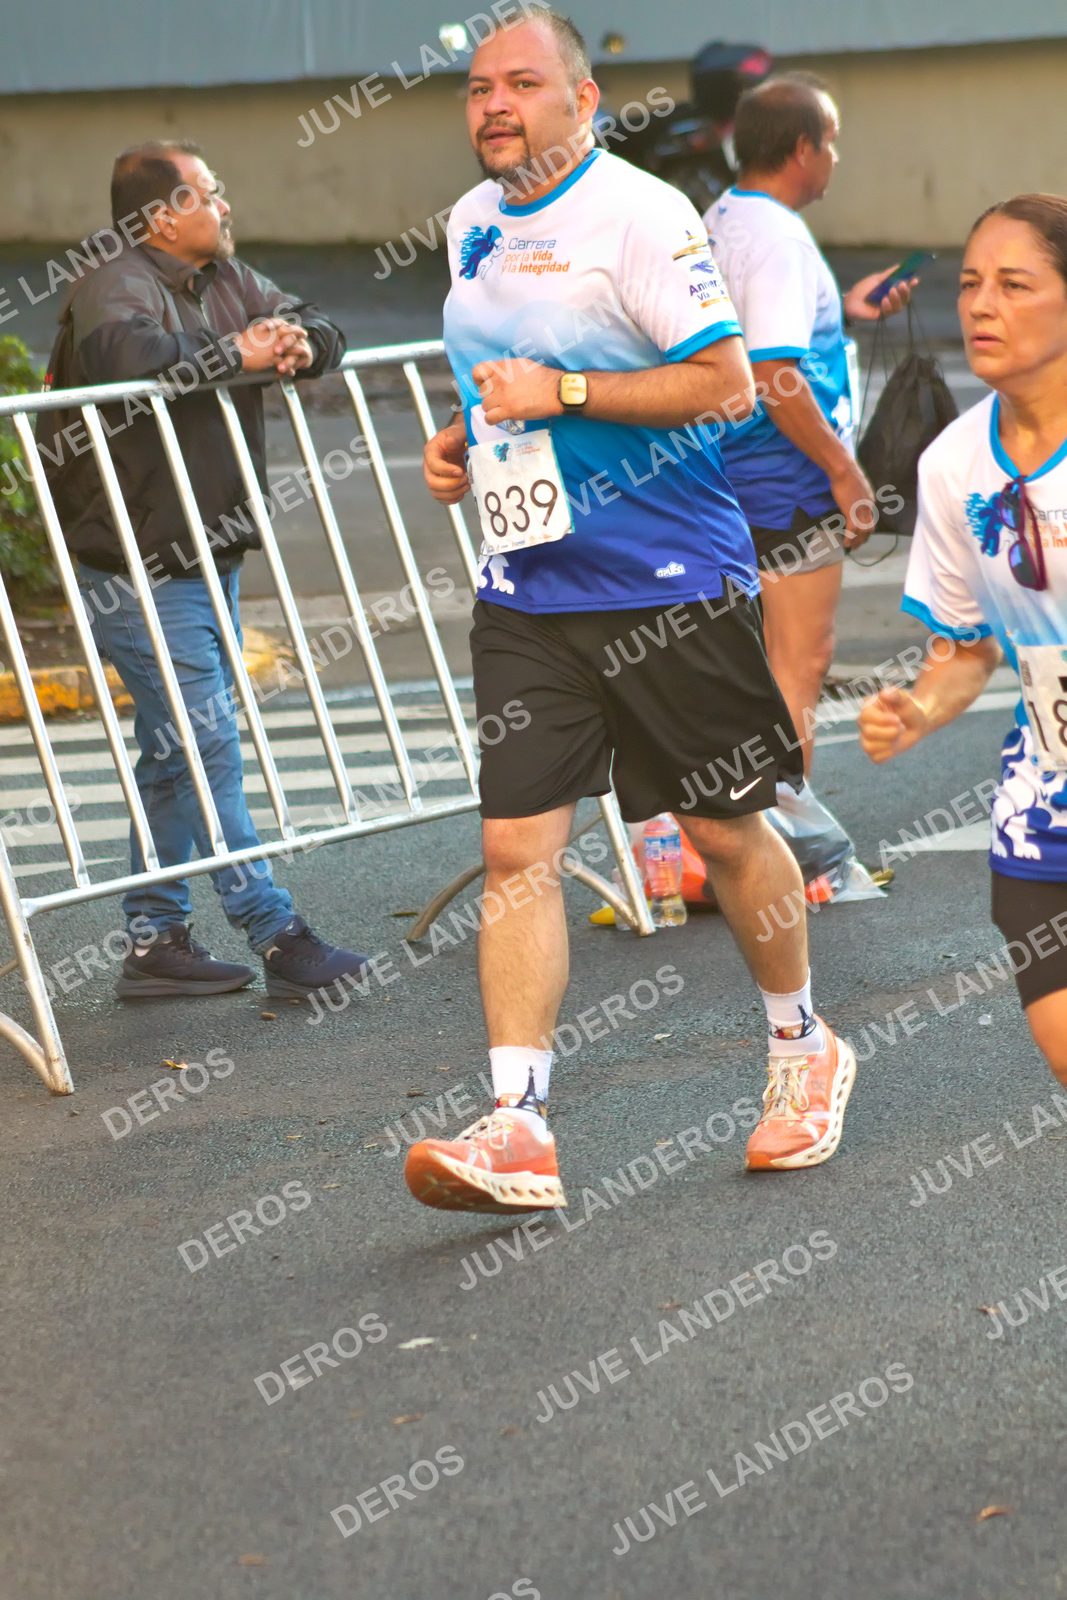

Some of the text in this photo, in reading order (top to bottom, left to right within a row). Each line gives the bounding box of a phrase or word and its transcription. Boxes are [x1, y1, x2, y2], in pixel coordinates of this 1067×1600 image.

[508, 238, 557, 250] Carrera
[532, 250, 553, 261] Vida
[519, 262, 570, 275] Integridad
[484, 479, 558, 538] 839
